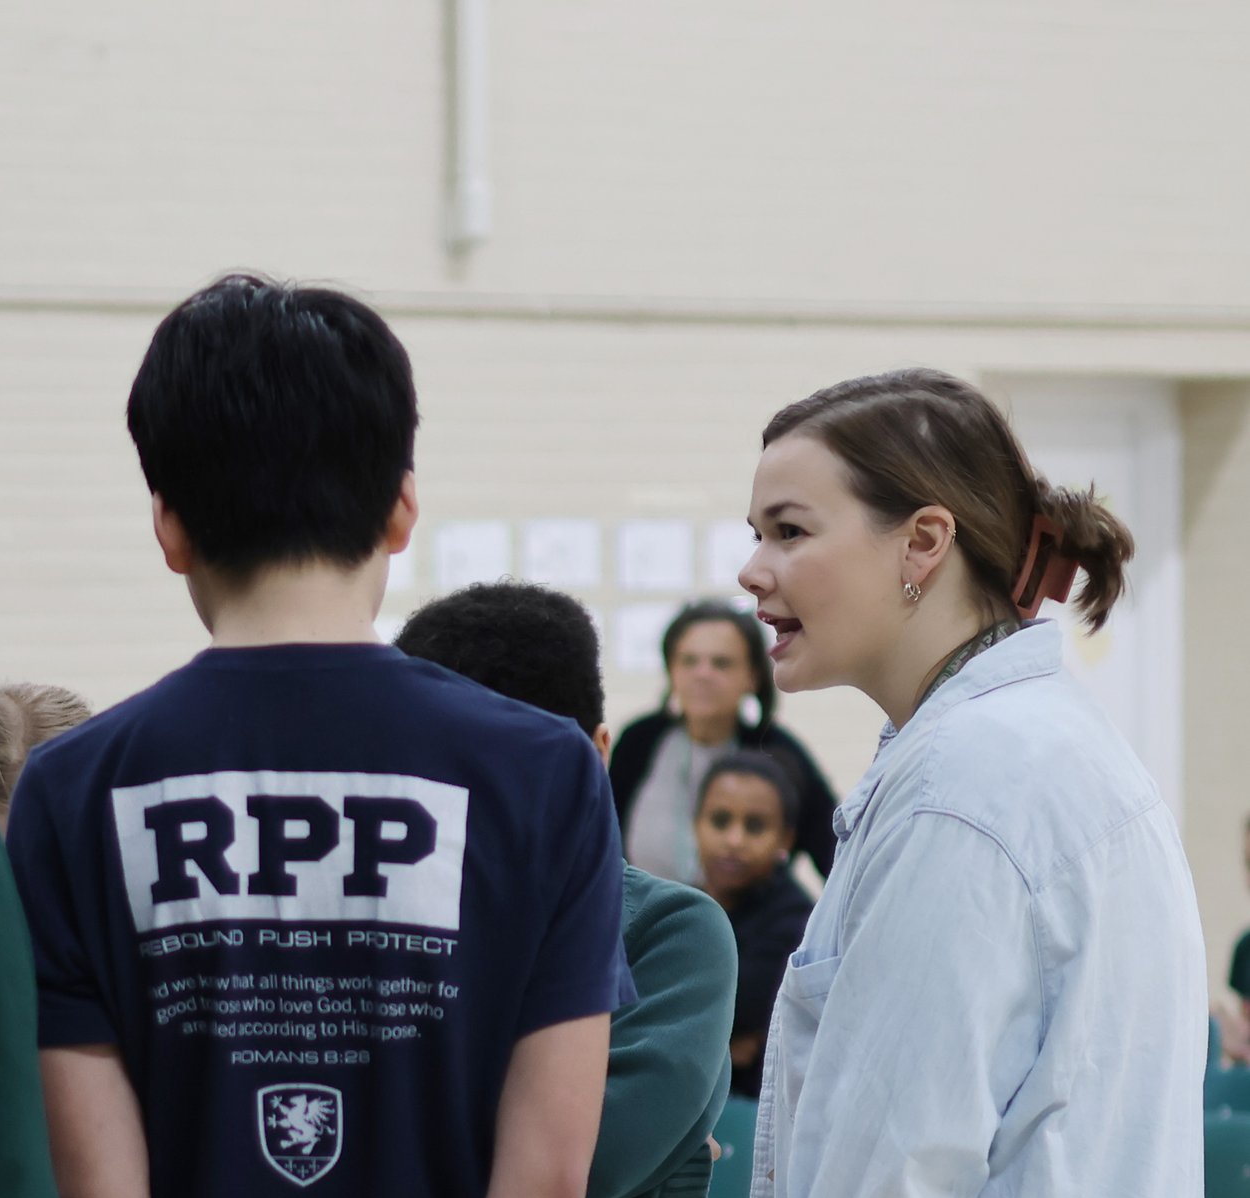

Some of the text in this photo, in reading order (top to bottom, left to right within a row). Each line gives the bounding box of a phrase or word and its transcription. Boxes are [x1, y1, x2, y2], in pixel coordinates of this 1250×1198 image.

[143, 795, 438, 905] RPP
[258, 929, 332, 947] PUSH
[172, 978, 196, 992] we
[259, 974, 278, 989] all
[281, 974, 335, 993] things
[438, 980, 460, 998] for
[156, 997, 198, 1025] good
[242, 996, 276, 1012] who
[280, 997, 314, 1014] love
[317, 996, 357, 1014] God,
[409, 1001, 444, 1020] who
[320, 1021, 338, 1036] to
[342, 1020, 368, 1036] His
[231, 1050, 319, 1065] ROMANS
